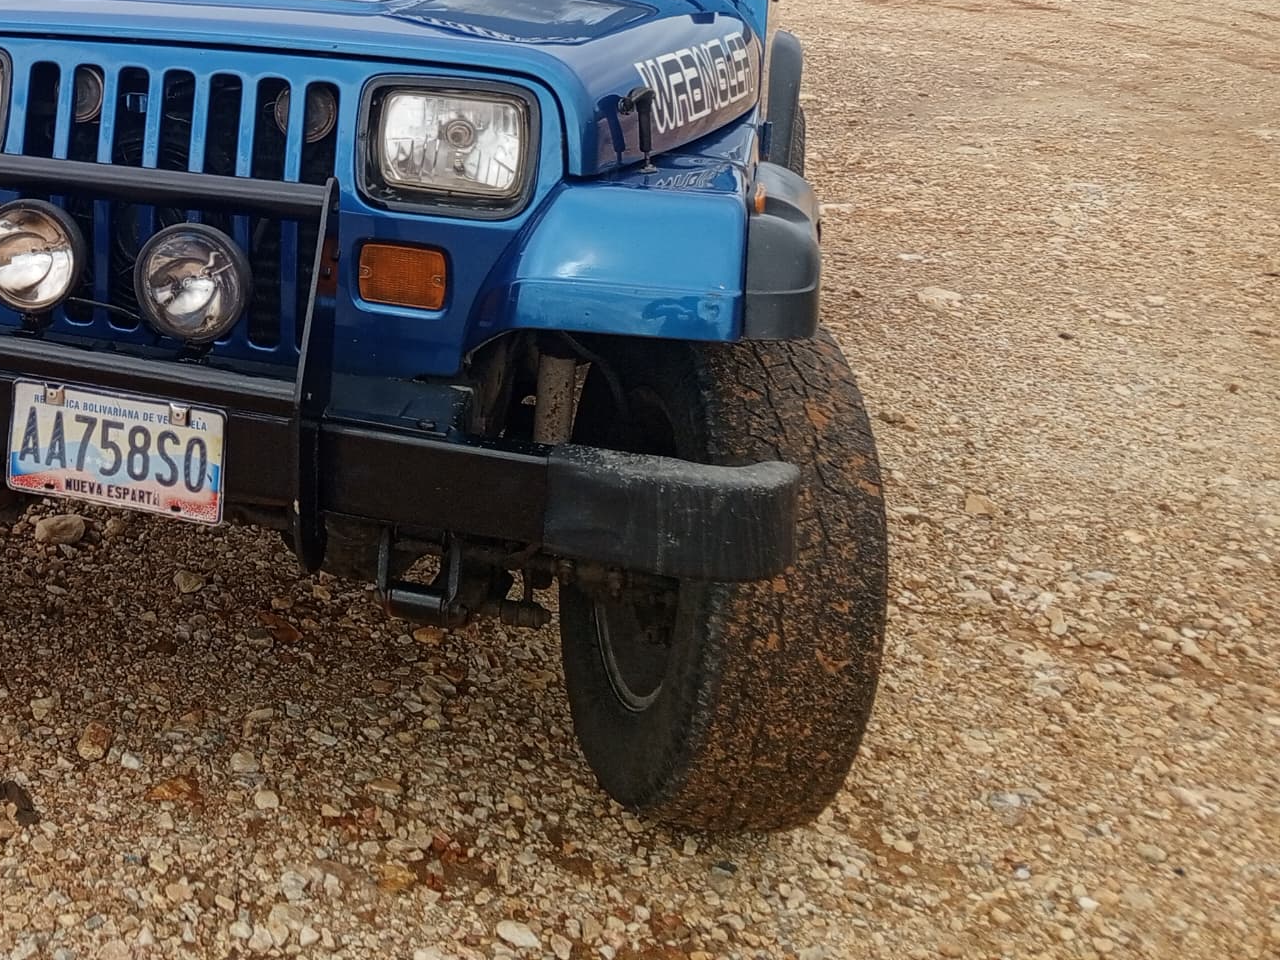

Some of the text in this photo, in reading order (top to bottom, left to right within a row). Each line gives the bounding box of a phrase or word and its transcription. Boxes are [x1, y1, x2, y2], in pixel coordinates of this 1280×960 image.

[34, 393, 80, 410] REICA
[82, 401, 140, 421] BOLIVARIANA
[142, 412, 154, 423] DE
[65, 478, 102, 496] NUEVA
